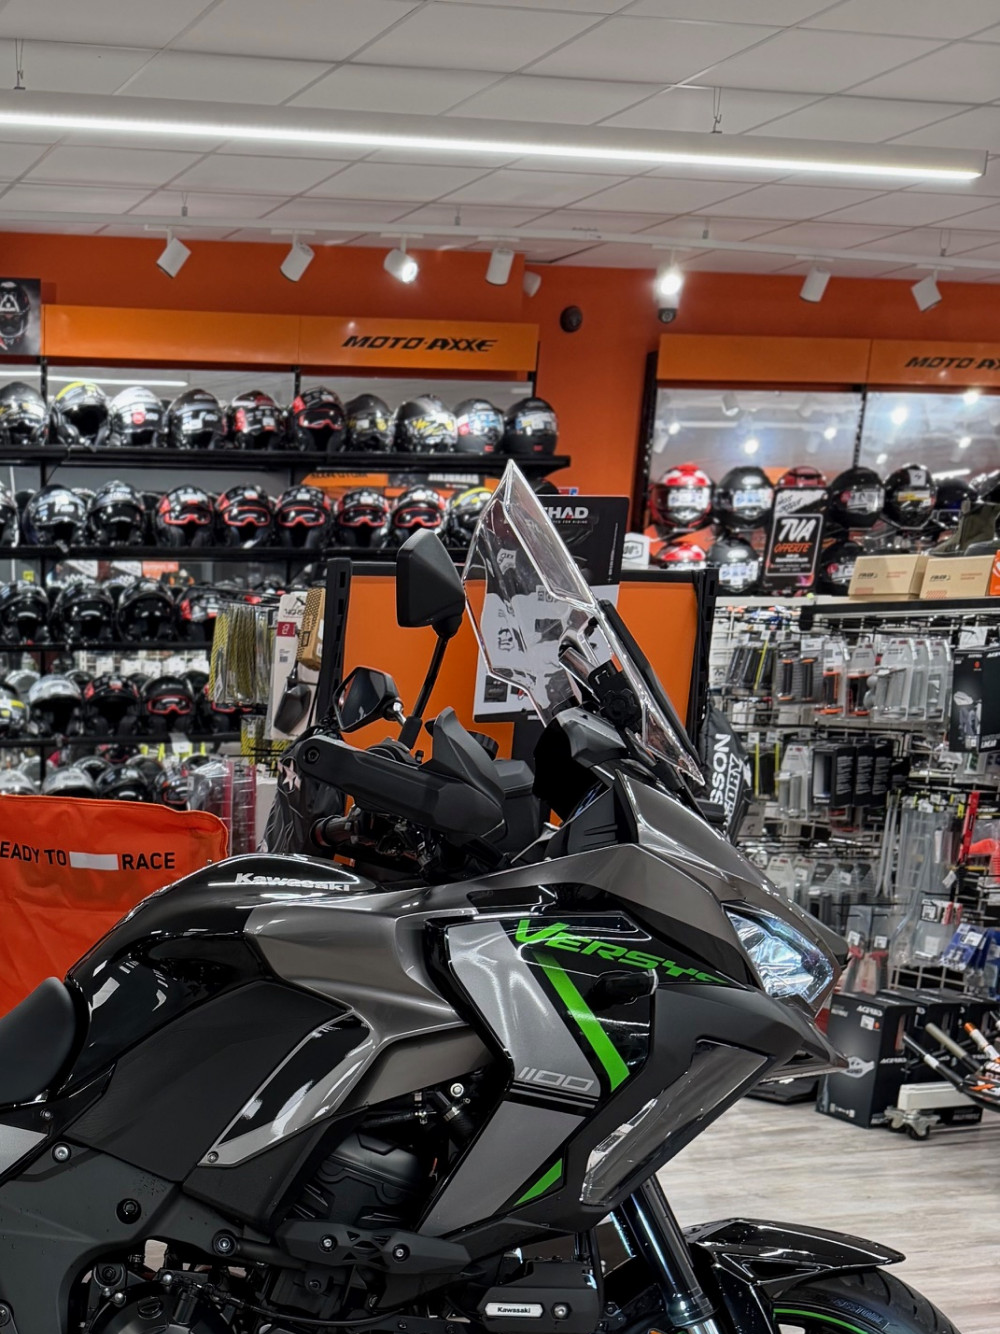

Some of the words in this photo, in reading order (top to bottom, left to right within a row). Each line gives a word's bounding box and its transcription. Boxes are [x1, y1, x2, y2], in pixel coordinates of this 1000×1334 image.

[544, 506, 589, 519] HAD
[778, 518, 817, 542] TVA
[774, 542, 812, 553] OFFERTE
[44, 849, 67, 866] TO
[121, 852, 176, 870] RACE
[234, 872, 350, 891] Kawasaki
[515, 919, 730, 984] VERSYS
[518, 1066, 594, 1092] 1100
[497, 1306, 531, 1314] Kawasaki
